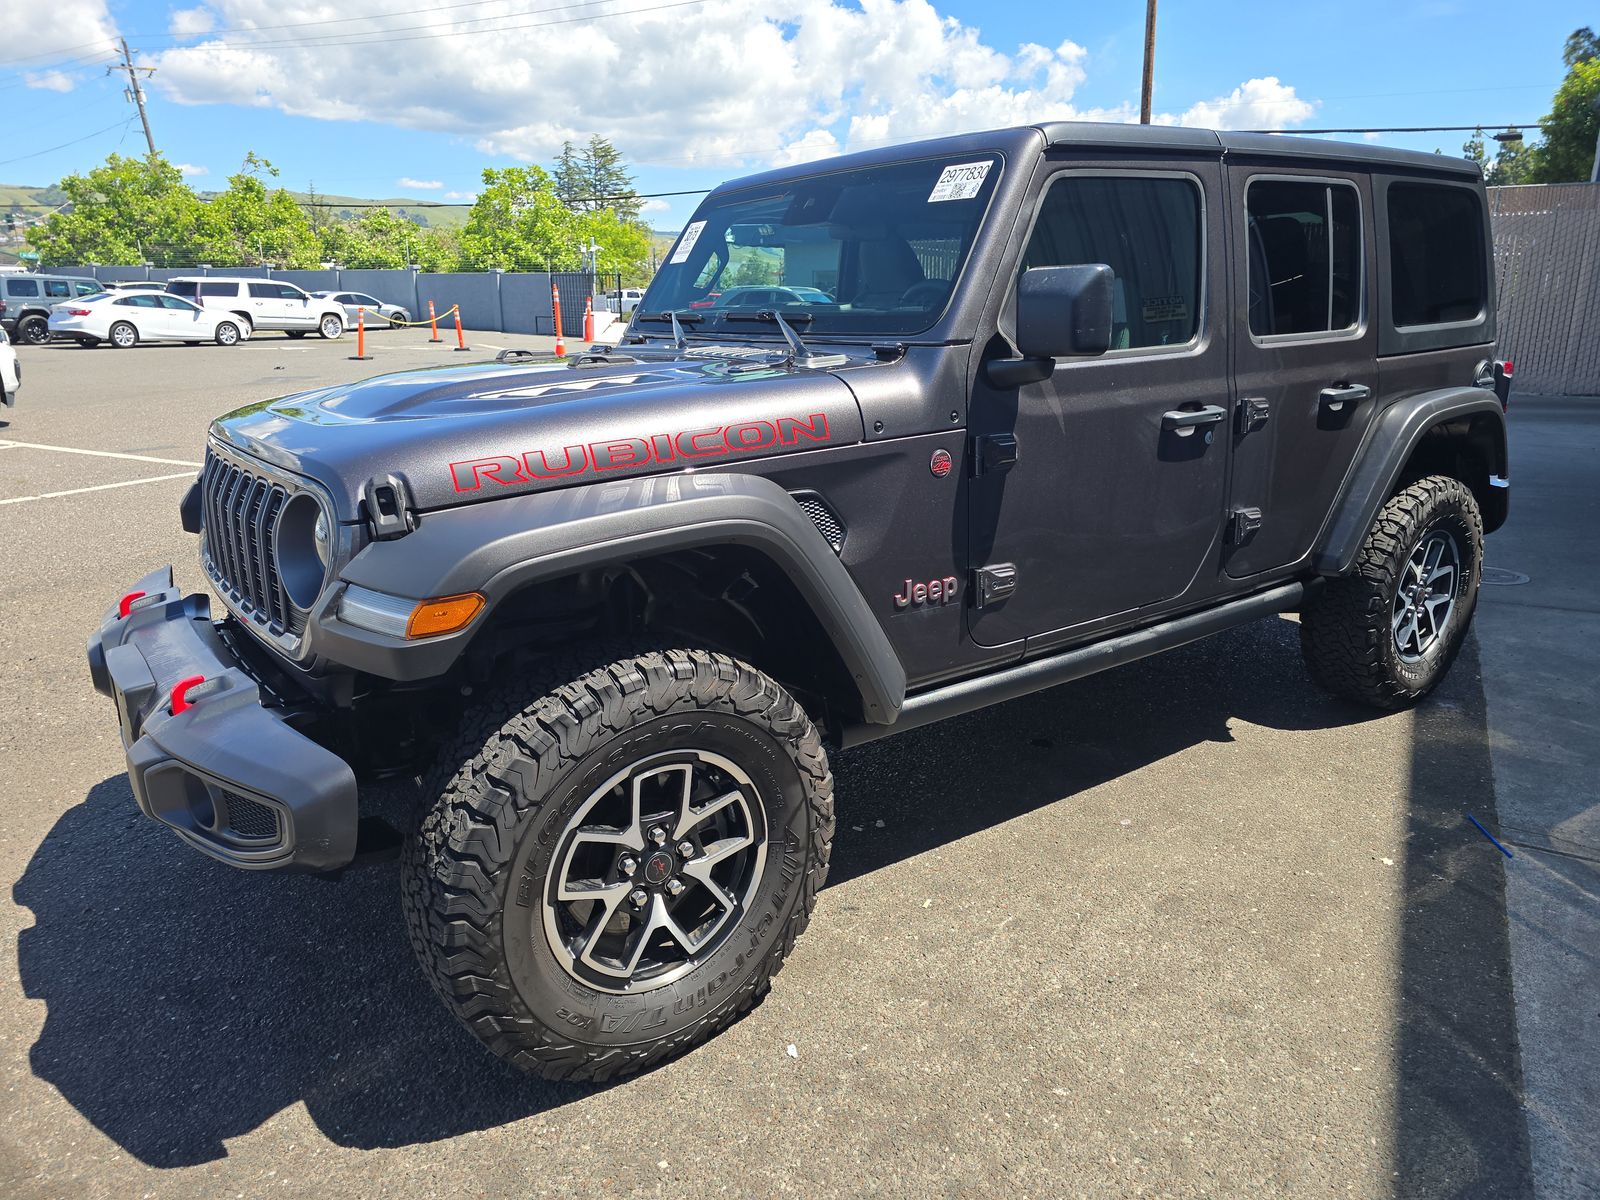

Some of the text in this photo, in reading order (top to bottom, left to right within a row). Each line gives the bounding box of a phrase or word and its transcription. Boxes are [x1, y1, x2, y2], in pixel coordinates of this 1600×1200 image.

[940, 165, 990, 183] 2977830
[449, 413, 831, 493] RUBICON
[895, 576, 957, 607] Jeep
[599, 1005, 667, 1035] T/A
